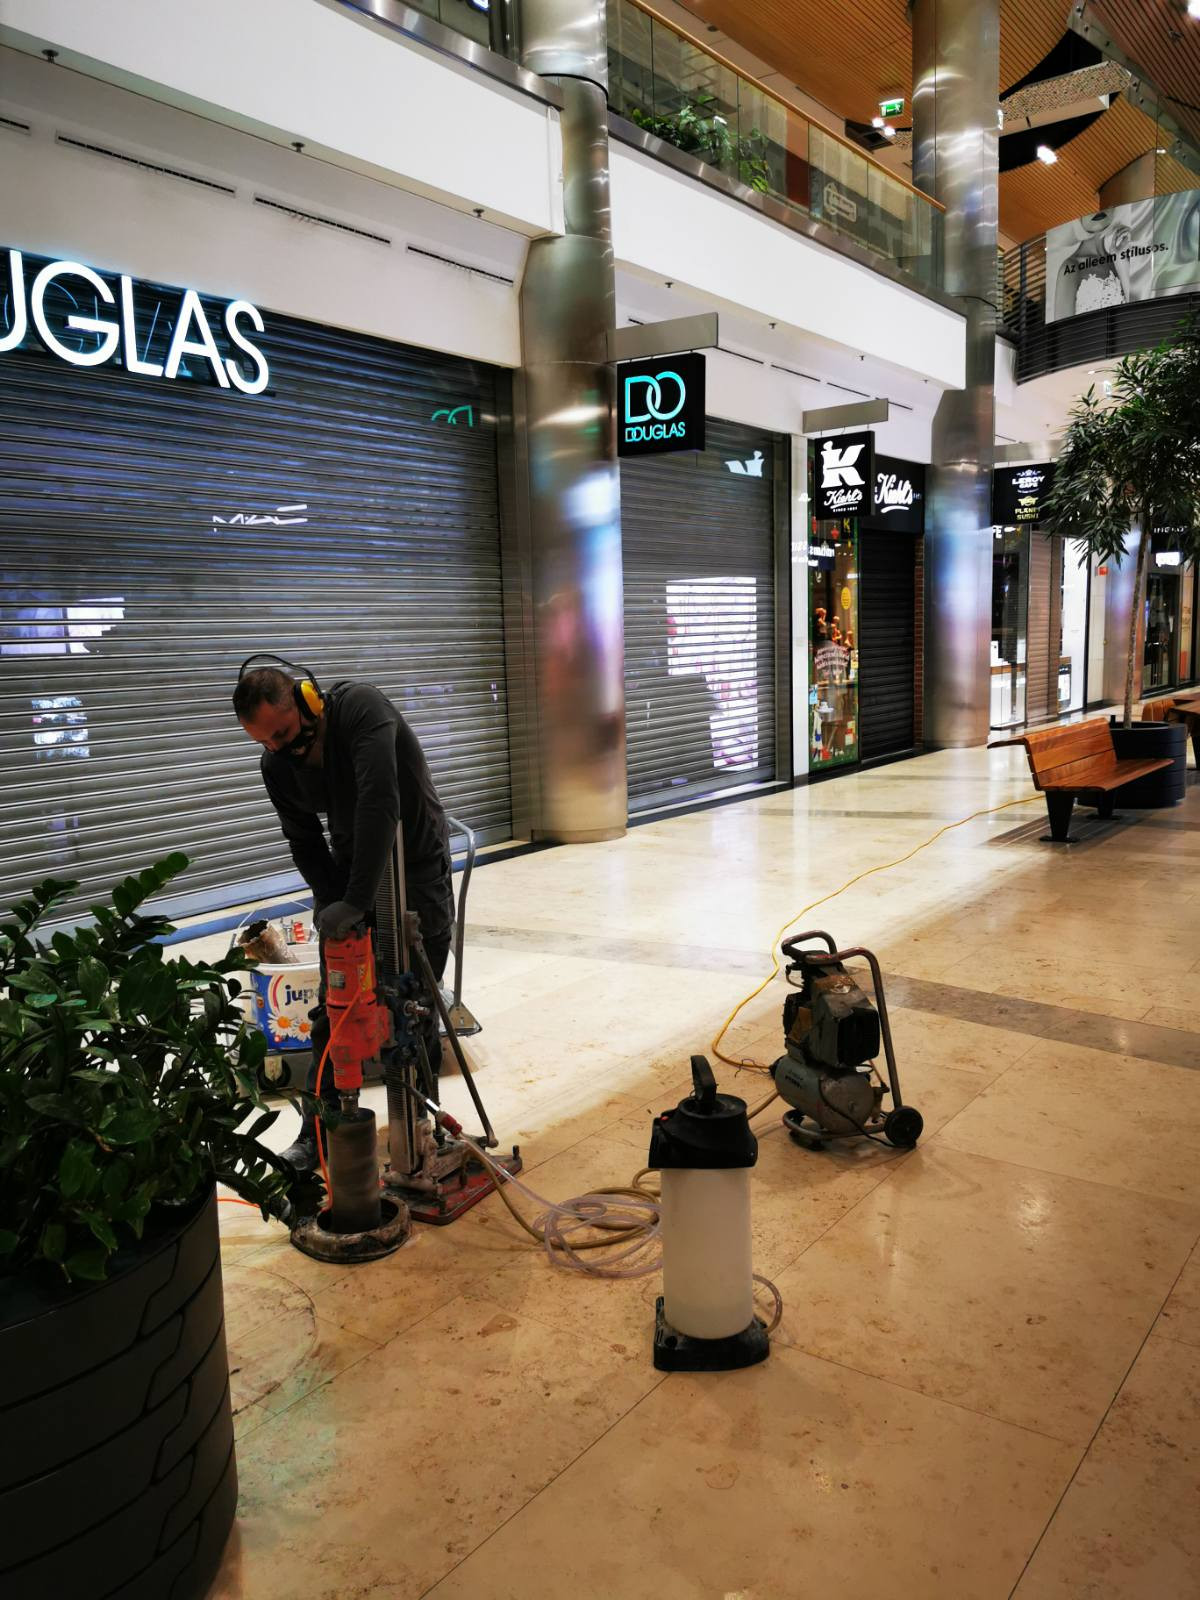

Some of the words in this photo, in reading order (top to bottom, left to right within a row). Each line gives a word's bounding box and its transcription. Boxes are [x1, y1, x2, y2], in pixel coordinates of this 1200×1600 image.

[1063, 265, 1076, 276] Az
[1078, 253, 1117, 270] alleem
[625, 422, 686, 442] DOUGLAS
[1011, 475, 1046, 485] LEROY
